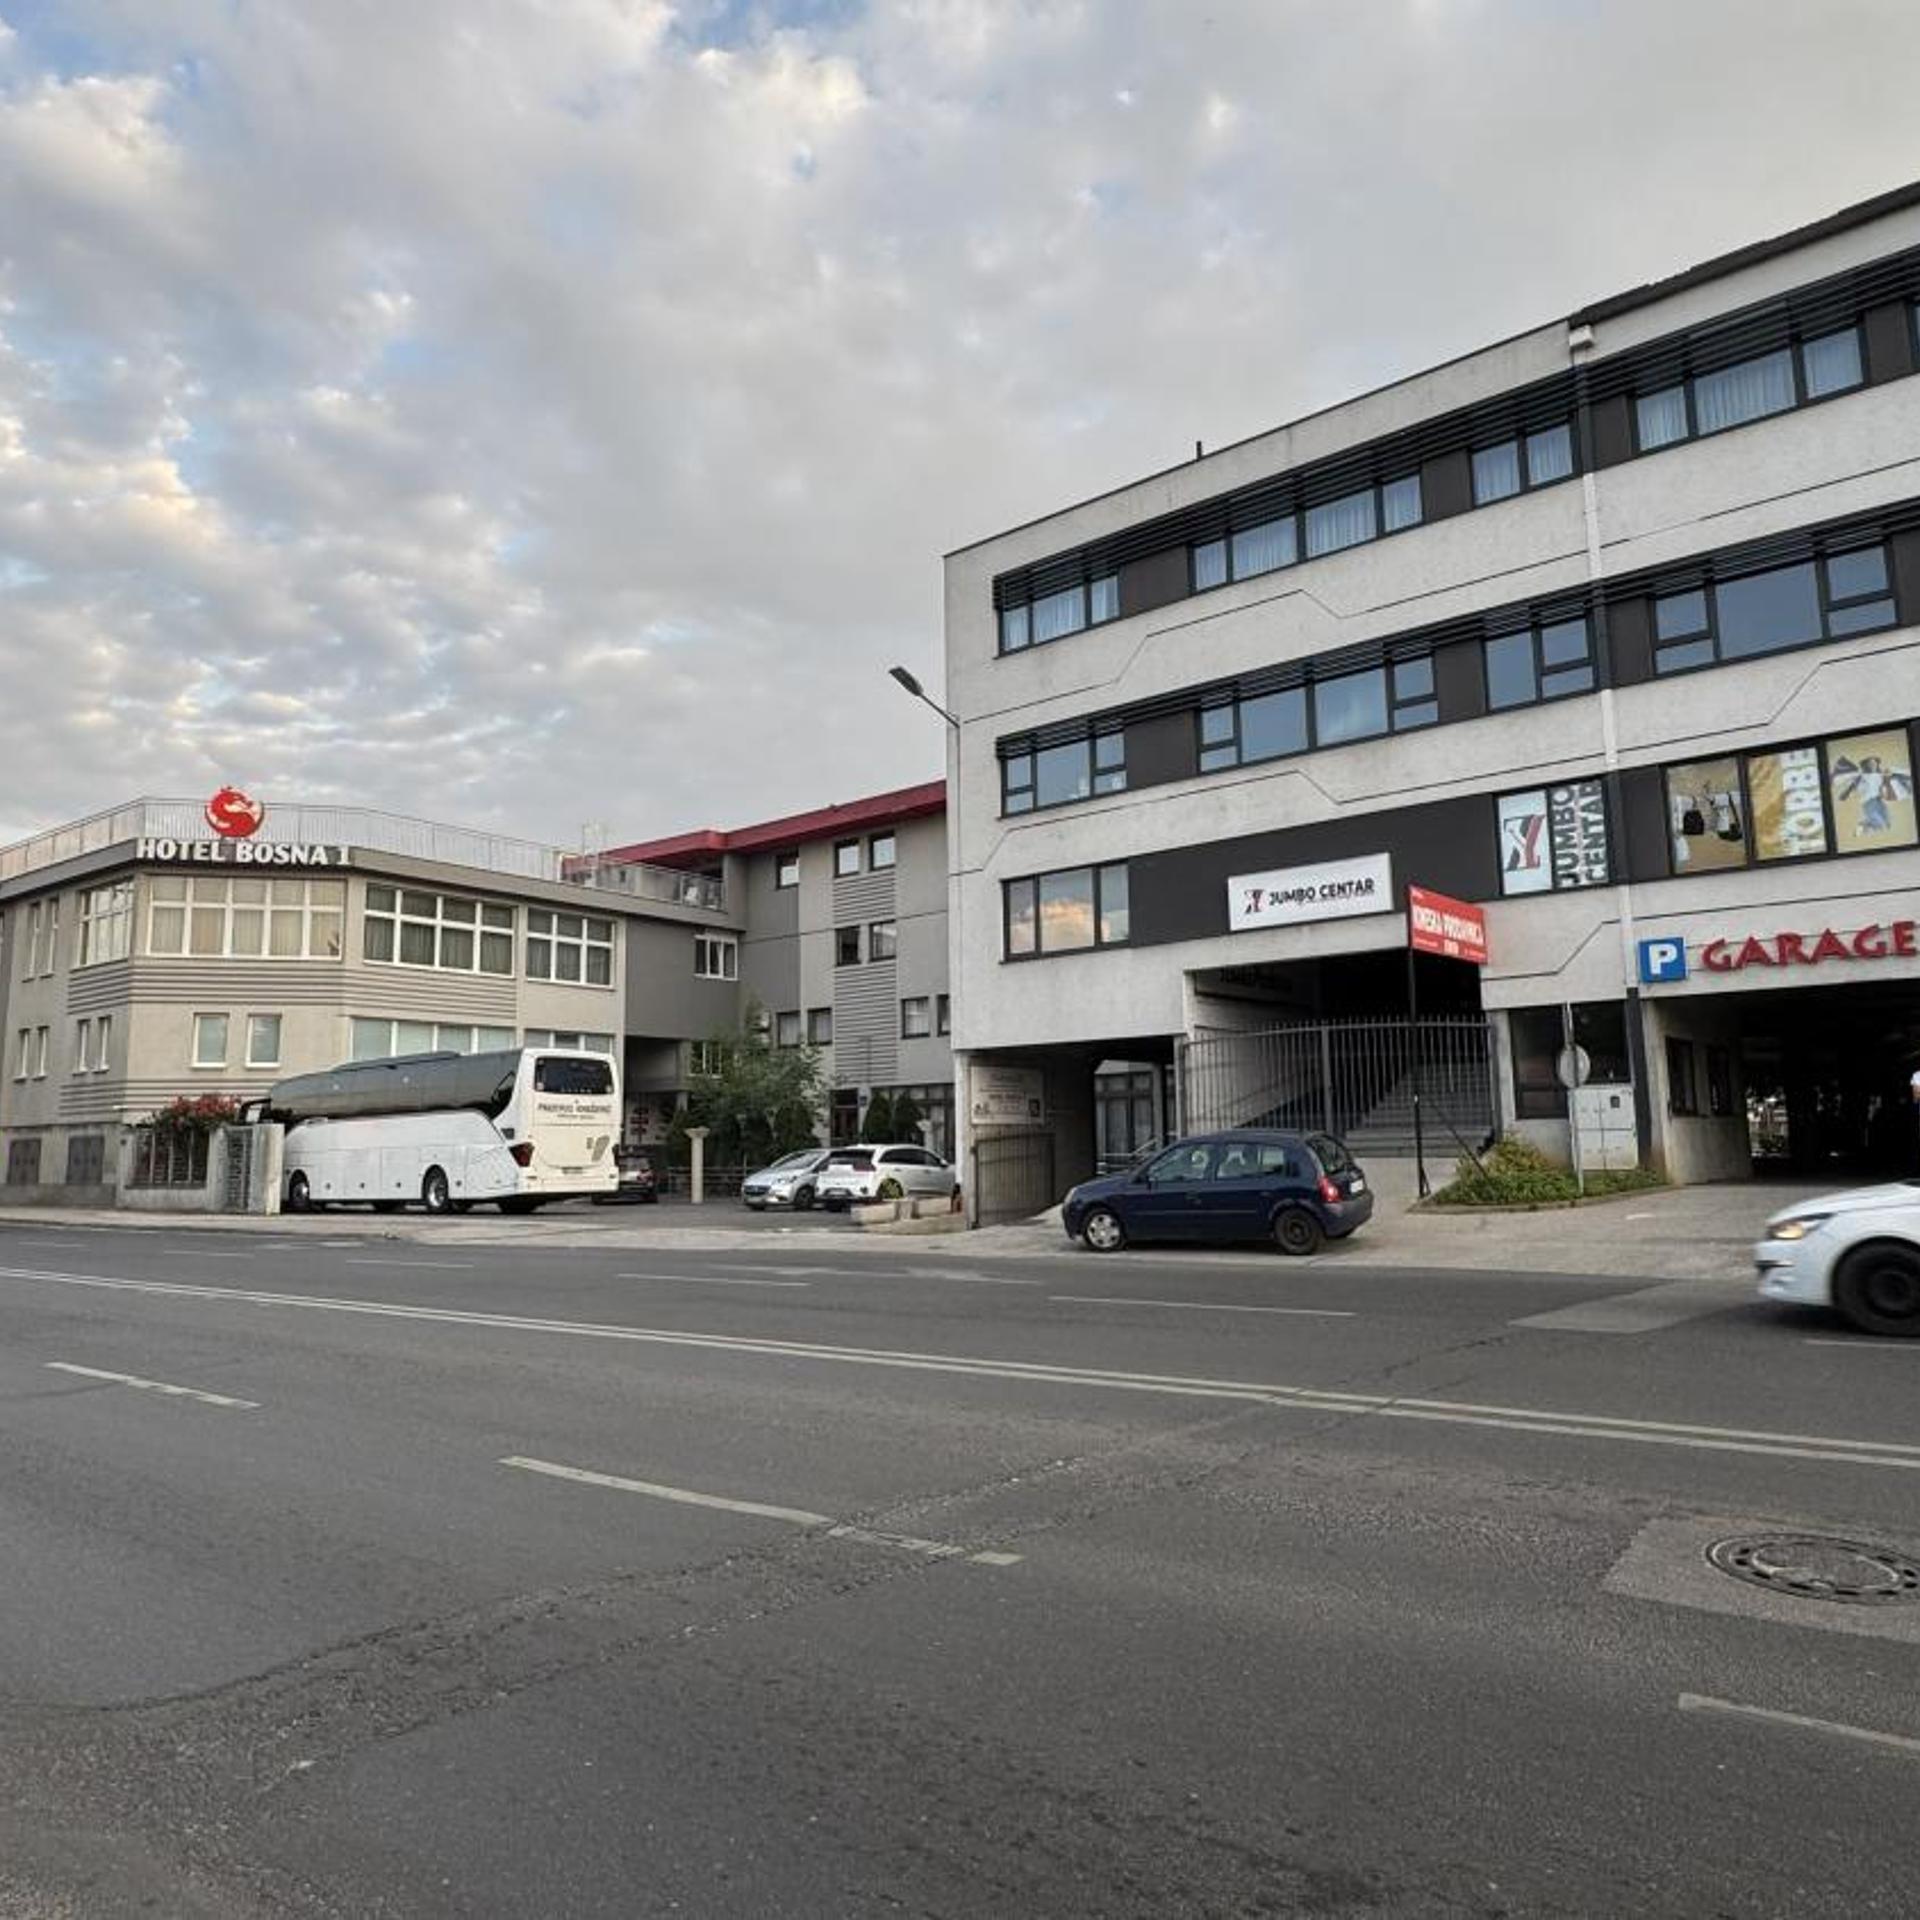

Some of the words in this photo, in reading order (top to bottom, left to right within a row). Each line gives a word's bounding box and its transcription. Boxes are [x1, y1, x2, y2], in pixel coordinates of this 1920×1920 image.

[136, 838, 227, 862] HOTEL
[236, 842, 328, 865] BOSNA
[1551, 785, 1579, 884] JUMBO
[1579, 780, 1608, 883] CENTAR
[1269, 886, 1316, 906] JUMBO
[1320, 877, 1375, 899] CENTAR
[1649, 943, 1678, 975] P
[1702, 920, 1916, 972] GARAGE
